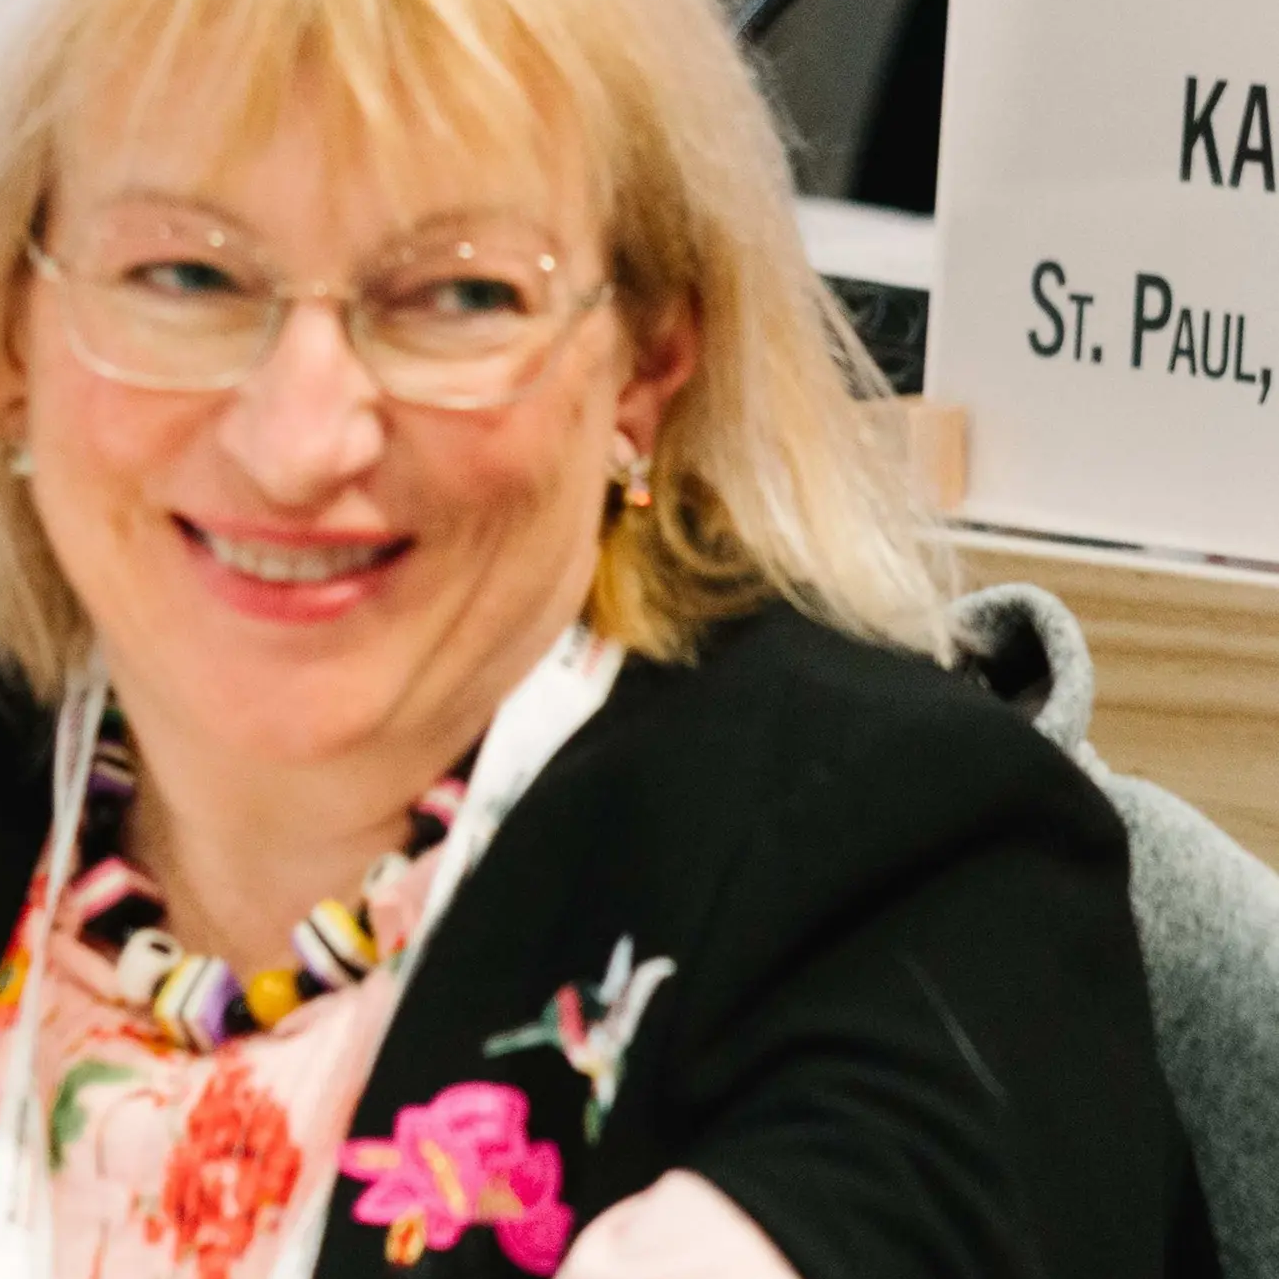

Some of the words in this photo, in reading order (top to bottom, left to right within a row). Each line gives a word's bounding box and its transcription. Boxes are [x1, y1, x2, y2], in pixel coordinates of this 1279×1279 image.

[1179, 75, 1276, 193] KA
[1027, 257, 1103, 364] ST.
[1130, 271, 1272, 404] PAUL,
